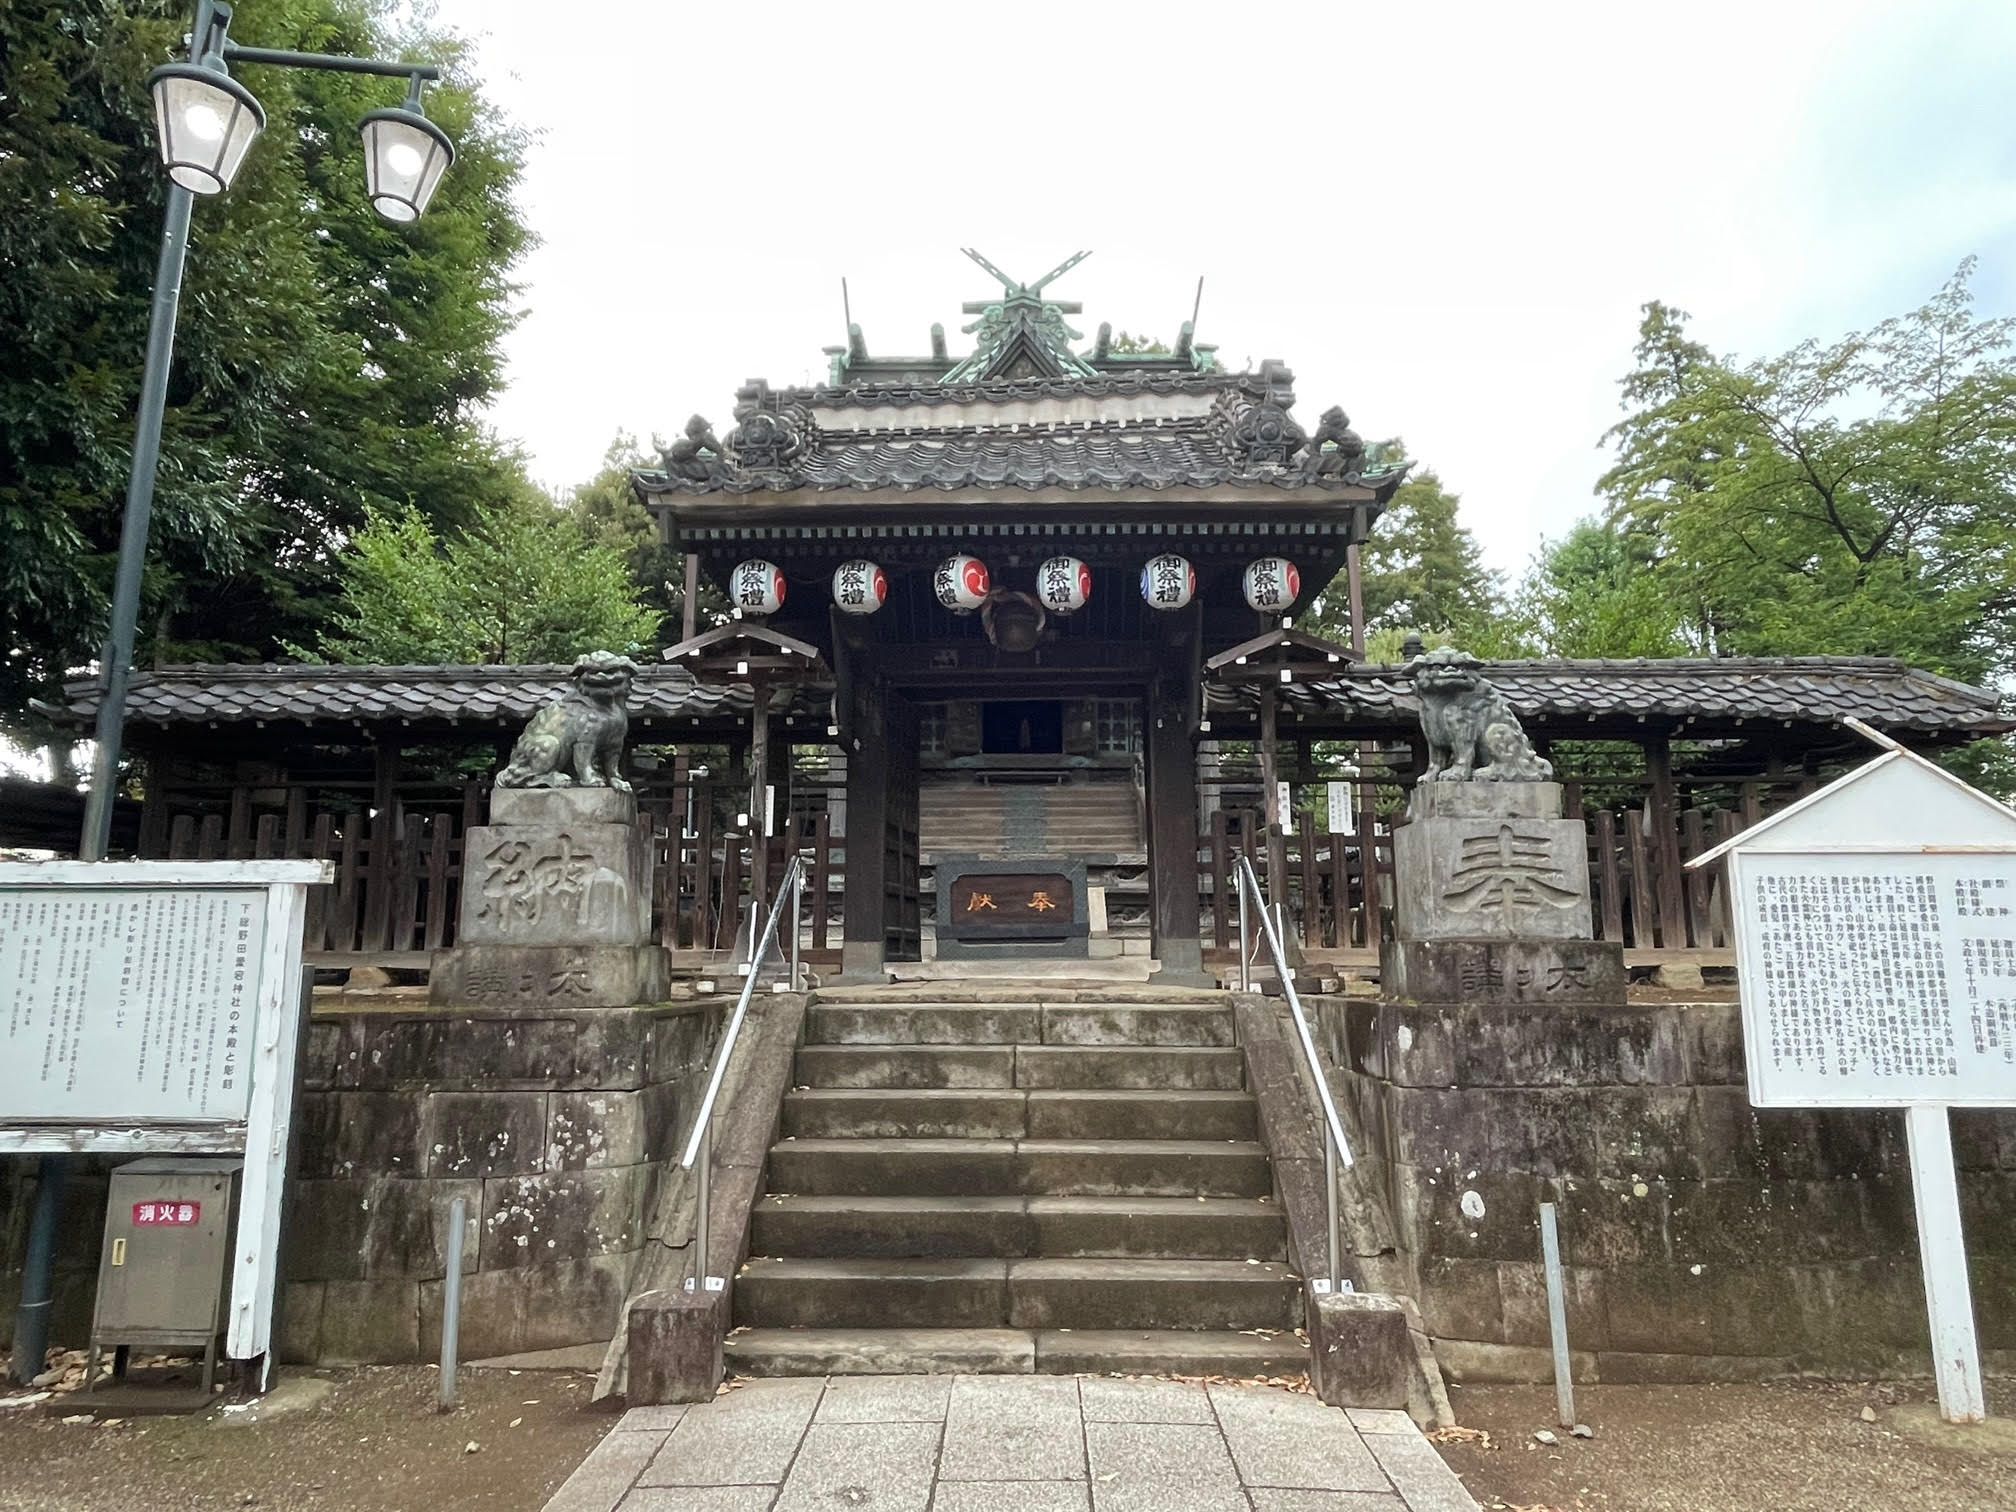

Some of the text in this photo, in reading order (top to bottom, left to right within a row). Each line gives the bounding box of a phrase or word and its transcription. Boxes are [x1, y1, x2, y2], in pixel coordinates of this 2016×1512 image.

[1443, 824, 1581, 938] 奉
[139, 1204, 194, 1222] 消火器
